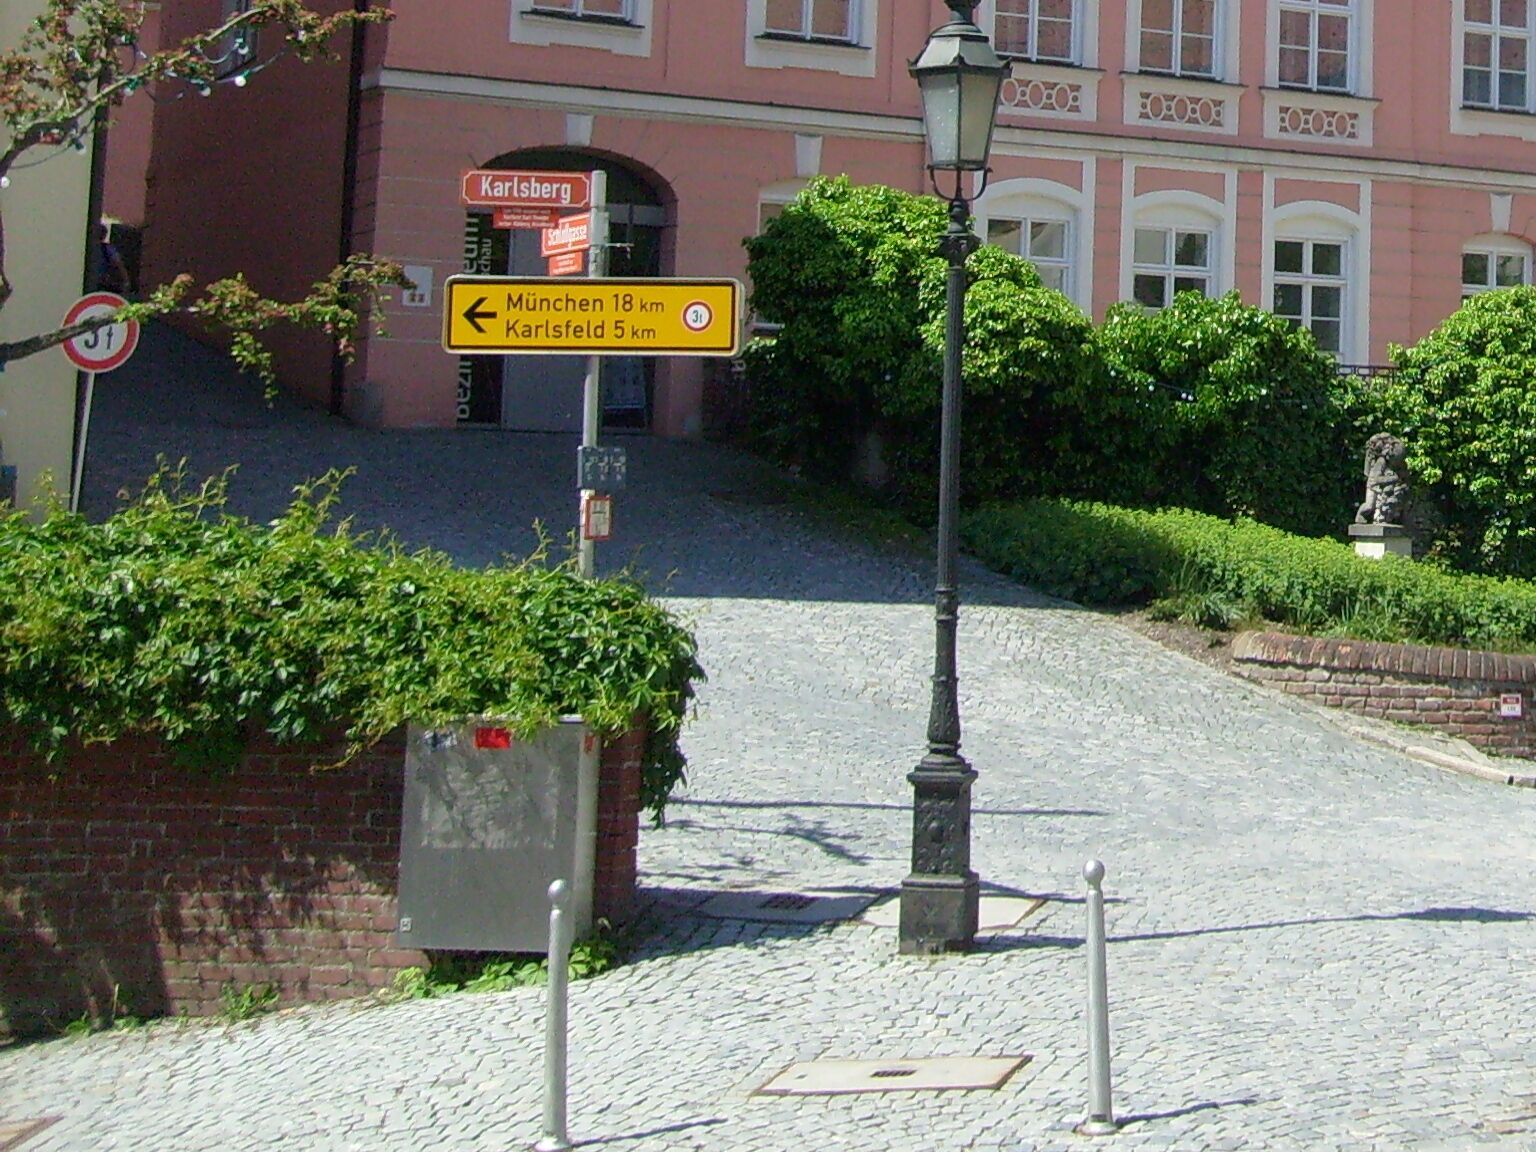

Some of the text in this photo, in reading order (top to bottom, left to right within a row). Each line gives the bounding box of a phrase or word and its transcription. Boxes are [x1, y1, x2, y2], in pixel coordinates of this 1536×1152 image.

[480, 175, 572, 205] Karlsberg
[506, 292, 665, 313] München 18 km
[505, 319, 656, 339] Karlsfeld 5 km
